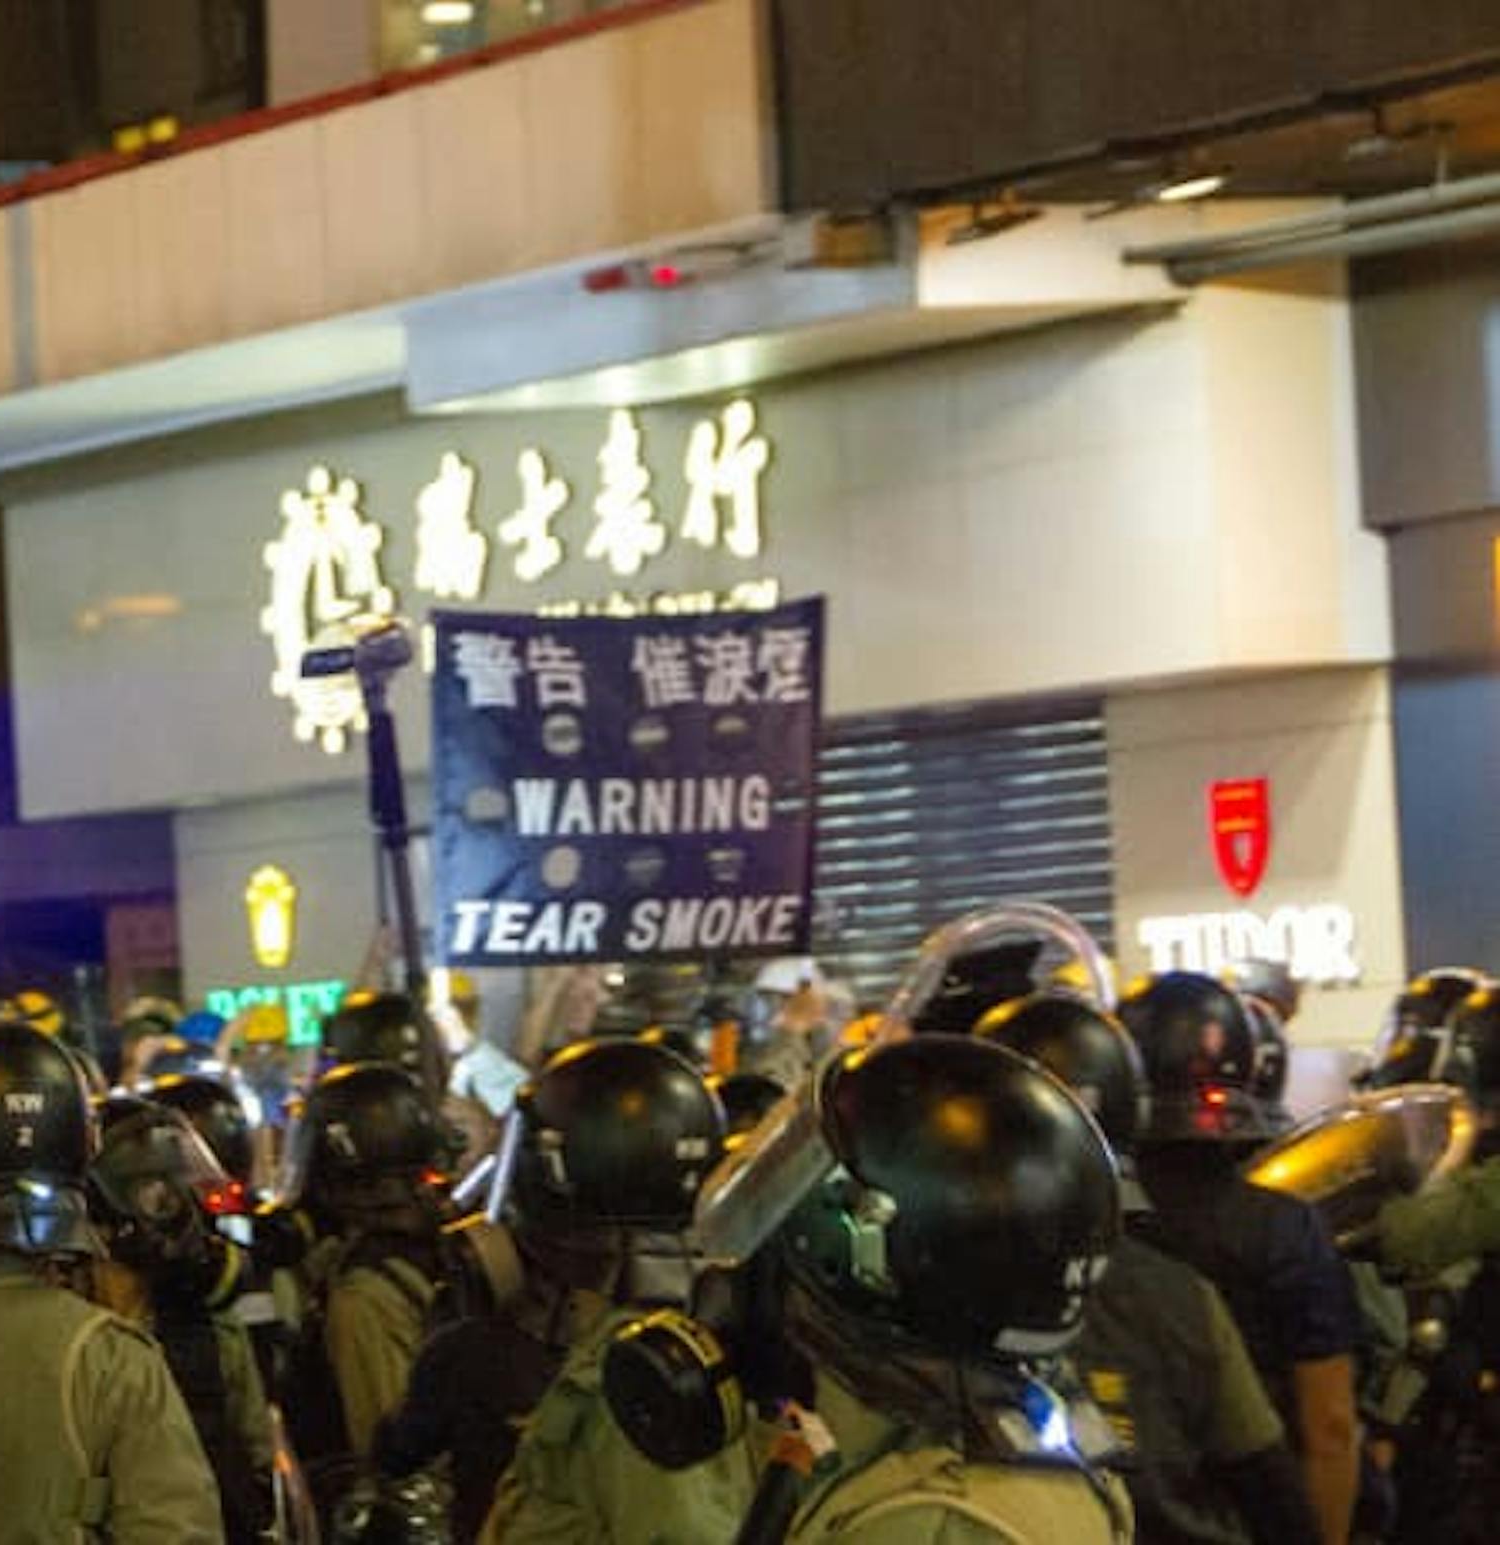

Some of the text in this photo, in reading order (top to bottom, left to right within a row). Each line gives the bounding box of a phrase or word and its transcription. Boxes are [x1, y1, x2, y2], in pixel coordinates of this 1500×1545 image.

[451, 630, 588, 708] 警告
[513, 775, 771, 836] WARNING
[451, 895, 803, 954] TEAR SMOKE
